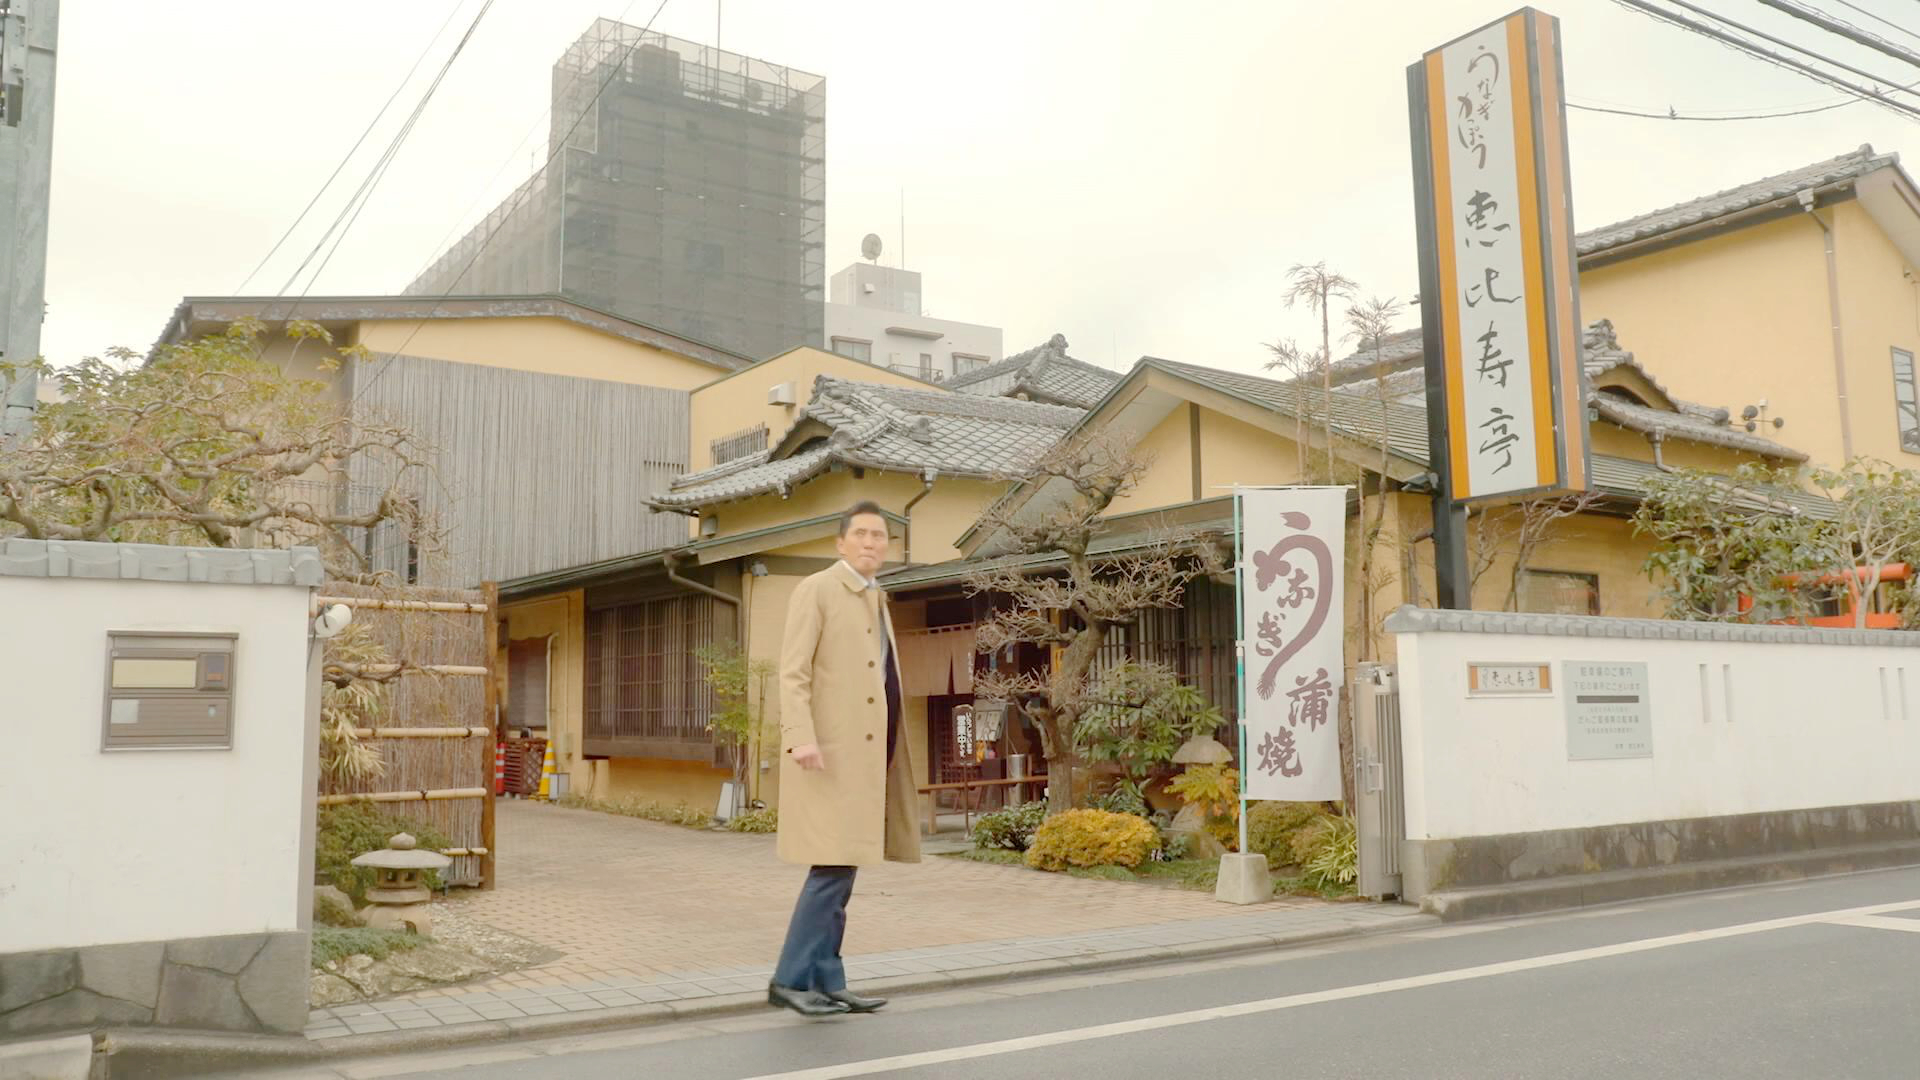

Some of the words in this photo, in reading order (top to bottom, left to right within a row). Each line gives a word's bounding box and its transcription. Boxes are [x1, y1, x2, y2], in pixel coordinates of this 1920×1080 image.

[1457, 92, 1487, 170] かっぽう
[1467, 45, 1499, 121] うなぎ
[1465, 189, 1522, 476] 恵比寿亭
[1252, 511, 1334, 701] うなぎ
